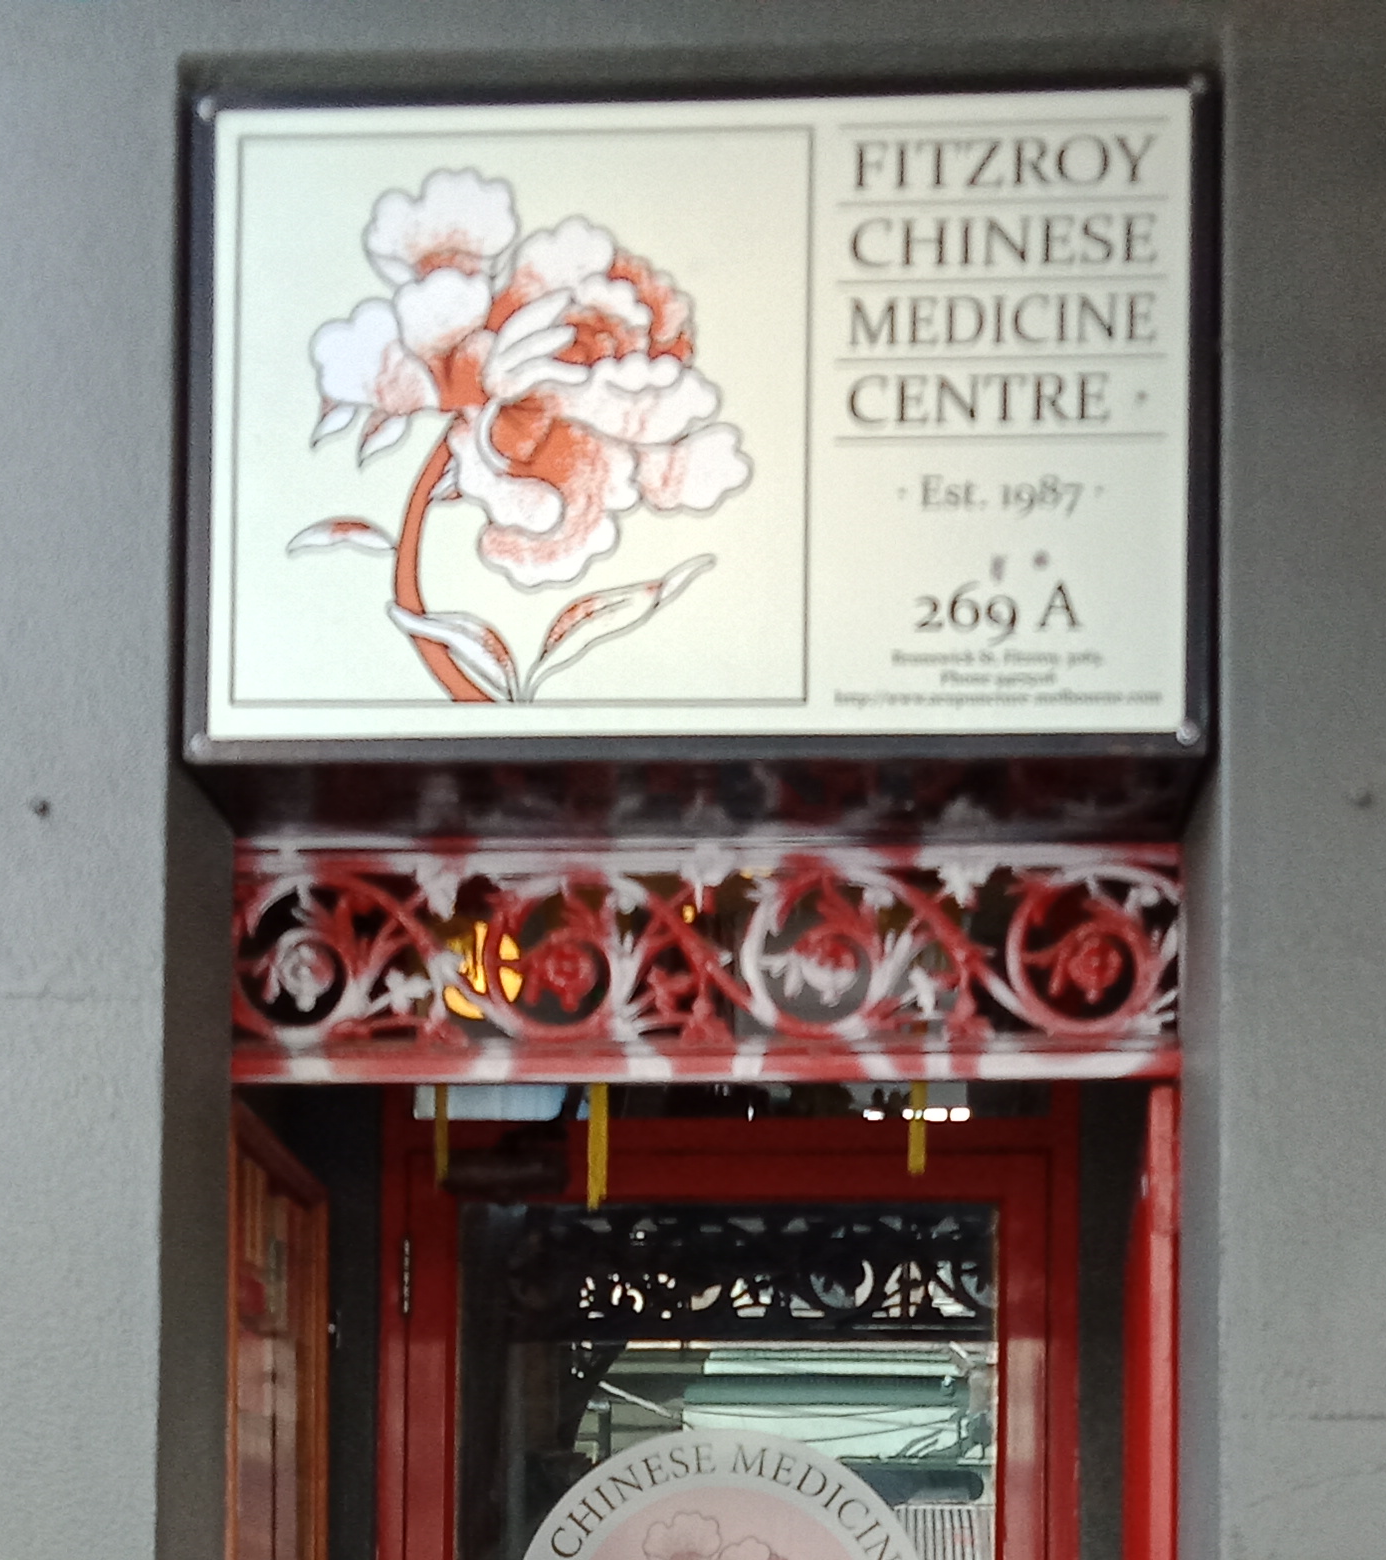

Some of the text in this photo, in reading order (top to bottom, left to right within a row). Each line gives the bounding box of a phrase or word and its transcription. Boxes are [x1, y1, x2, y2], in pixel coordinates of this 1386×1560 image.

[855, 133, 1157, 189] FITZROY
[850, 213, 1158, 268] CHINESE
[849, 292, 1157, 346] MEDICINE
[846, 371, 1111, 427] CENTRE
[920, 473, 1084, 518] Est. 1987
[914, 579, 1082, 647] 269 A
[551, 1444, 716, 1558] CHINESE
